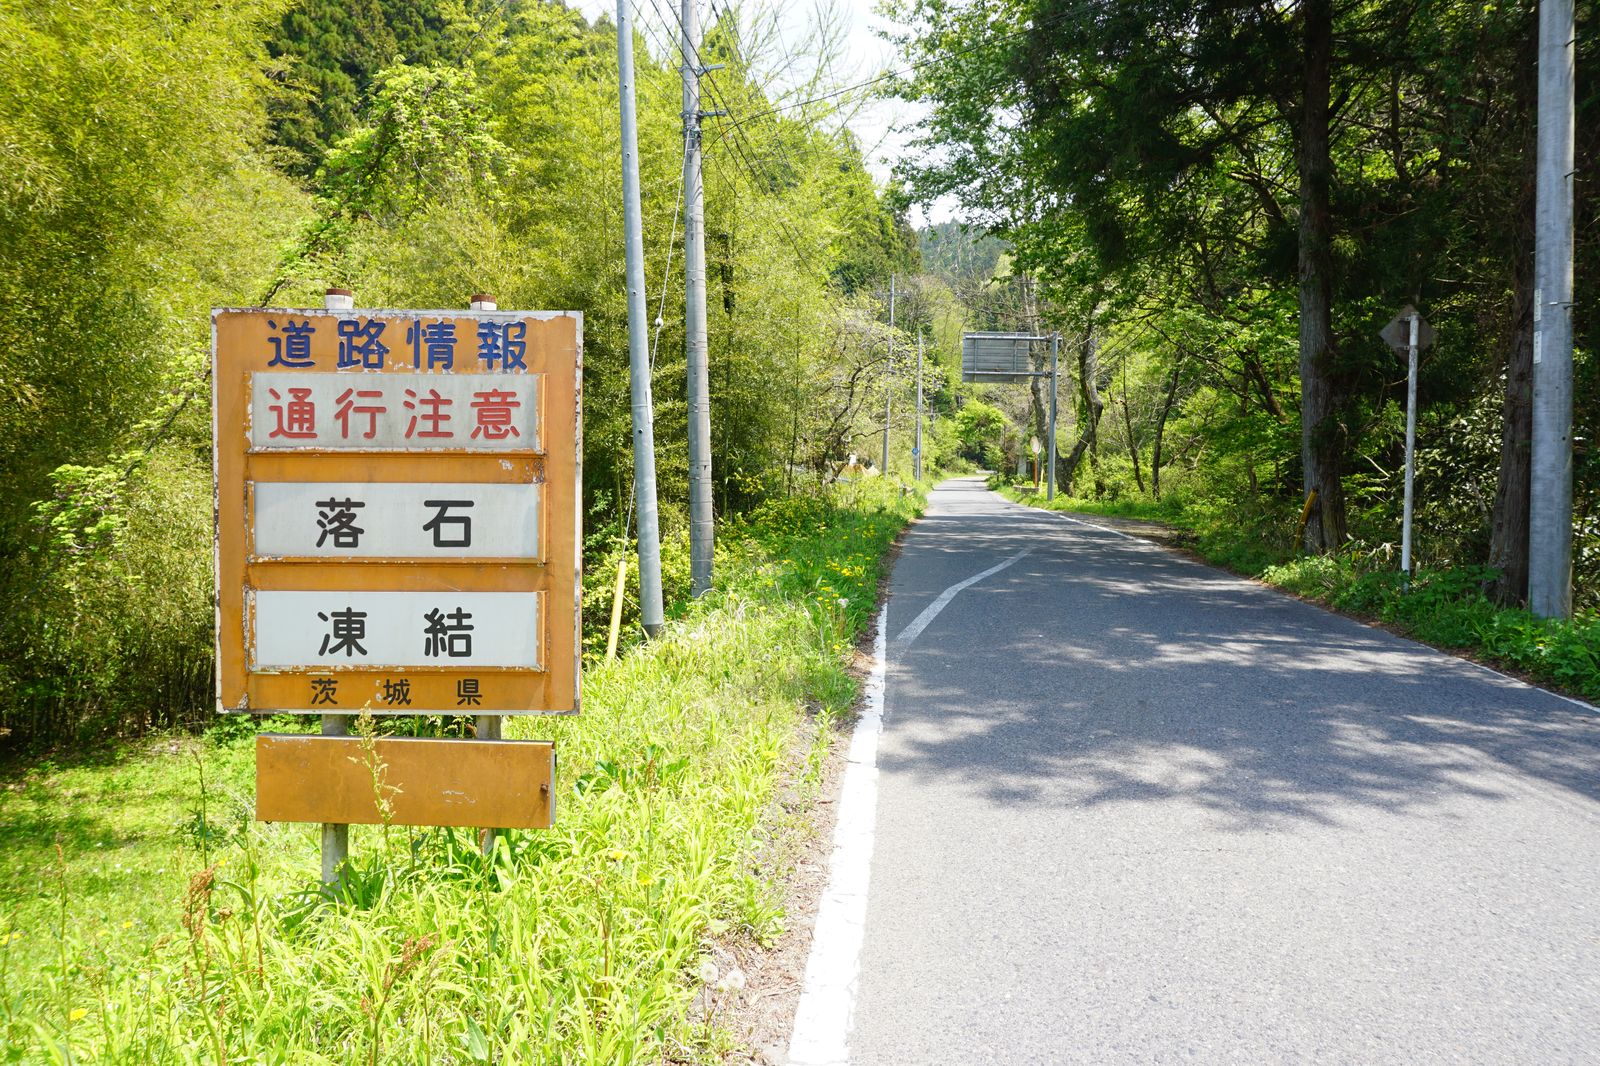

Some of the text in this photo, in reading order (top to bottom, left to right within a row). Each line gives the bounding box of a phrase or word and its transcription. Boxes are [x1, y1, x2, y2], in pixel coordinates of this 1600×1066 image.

[268, 320, 527, 369] 道路情報
[268, 388, 520, 439] 通行注意
[315, 497, 475, 548] 落石
[317, 607, 475, 657] 凍結
[311, 679, 483, 706] 茨城県
